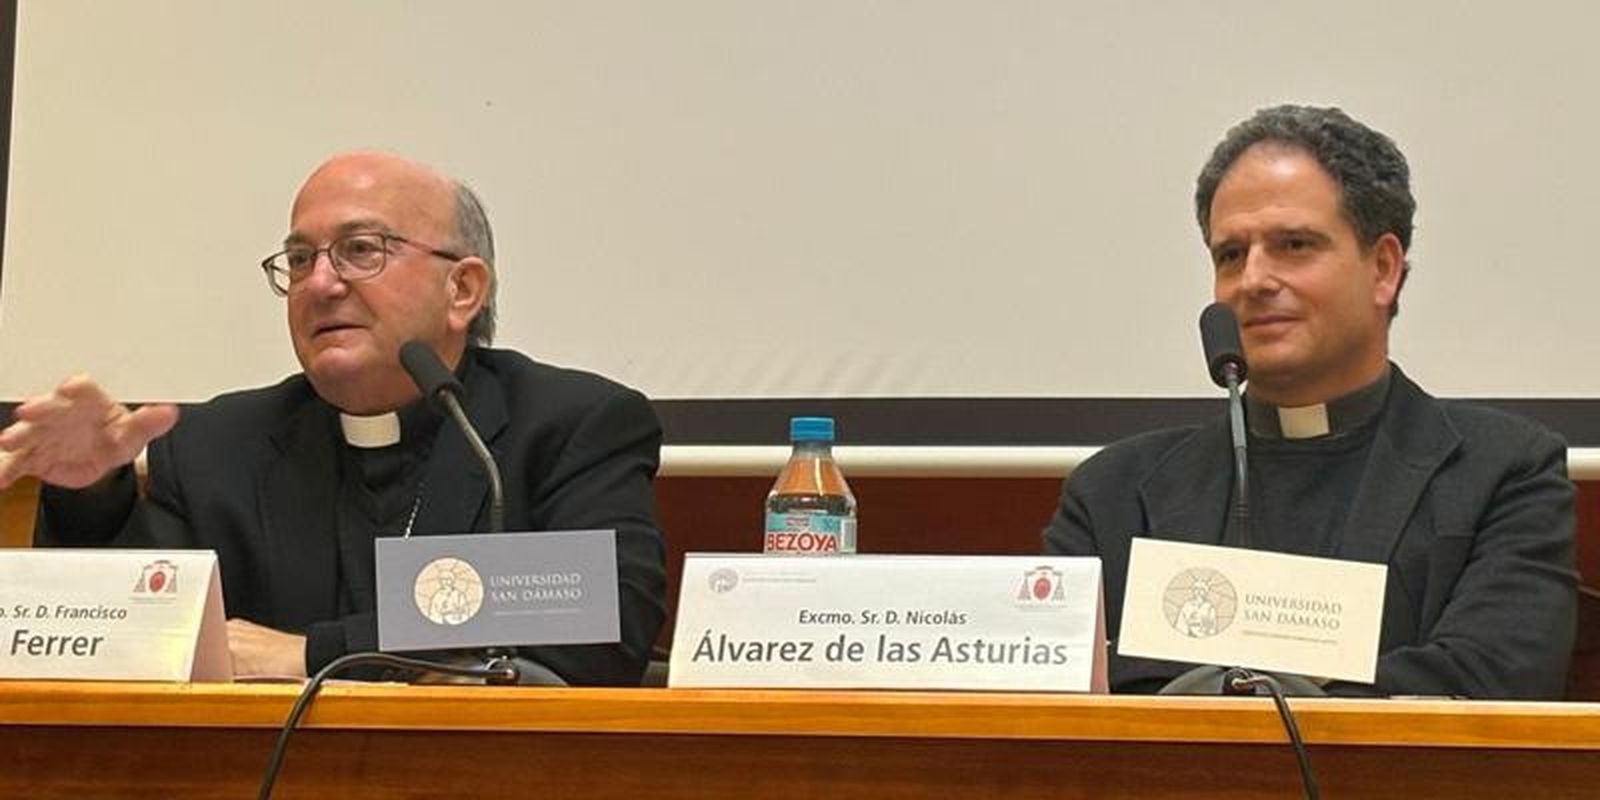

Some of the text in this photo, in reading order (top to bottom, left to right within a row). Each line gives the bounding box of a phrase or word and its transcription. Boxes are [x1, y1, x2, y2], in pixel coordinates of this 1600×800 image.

[767, 533, 837, 551] BEZOYA
[490, 573, 582, 588] UNIVERSIDAD
[491, 590, 519, 602] SAN
[1245, 594, 1342, 614] UNIVERSIDAD
[13, 605, 31, 619] Sr.
[35, 605, 50, 619] D.
[55, 604, 128, 620] Francisco
[799, 610, 855, 626] Excmo.
[861, 611, 880, 626] Sr.
[885, 610, 900, 625] D.
[1244, 610, 1272, 623] SAN
[10, 629, 104, 656] Ferrer
[692, 630, 1067, 666] Álvarez de las Asturias
